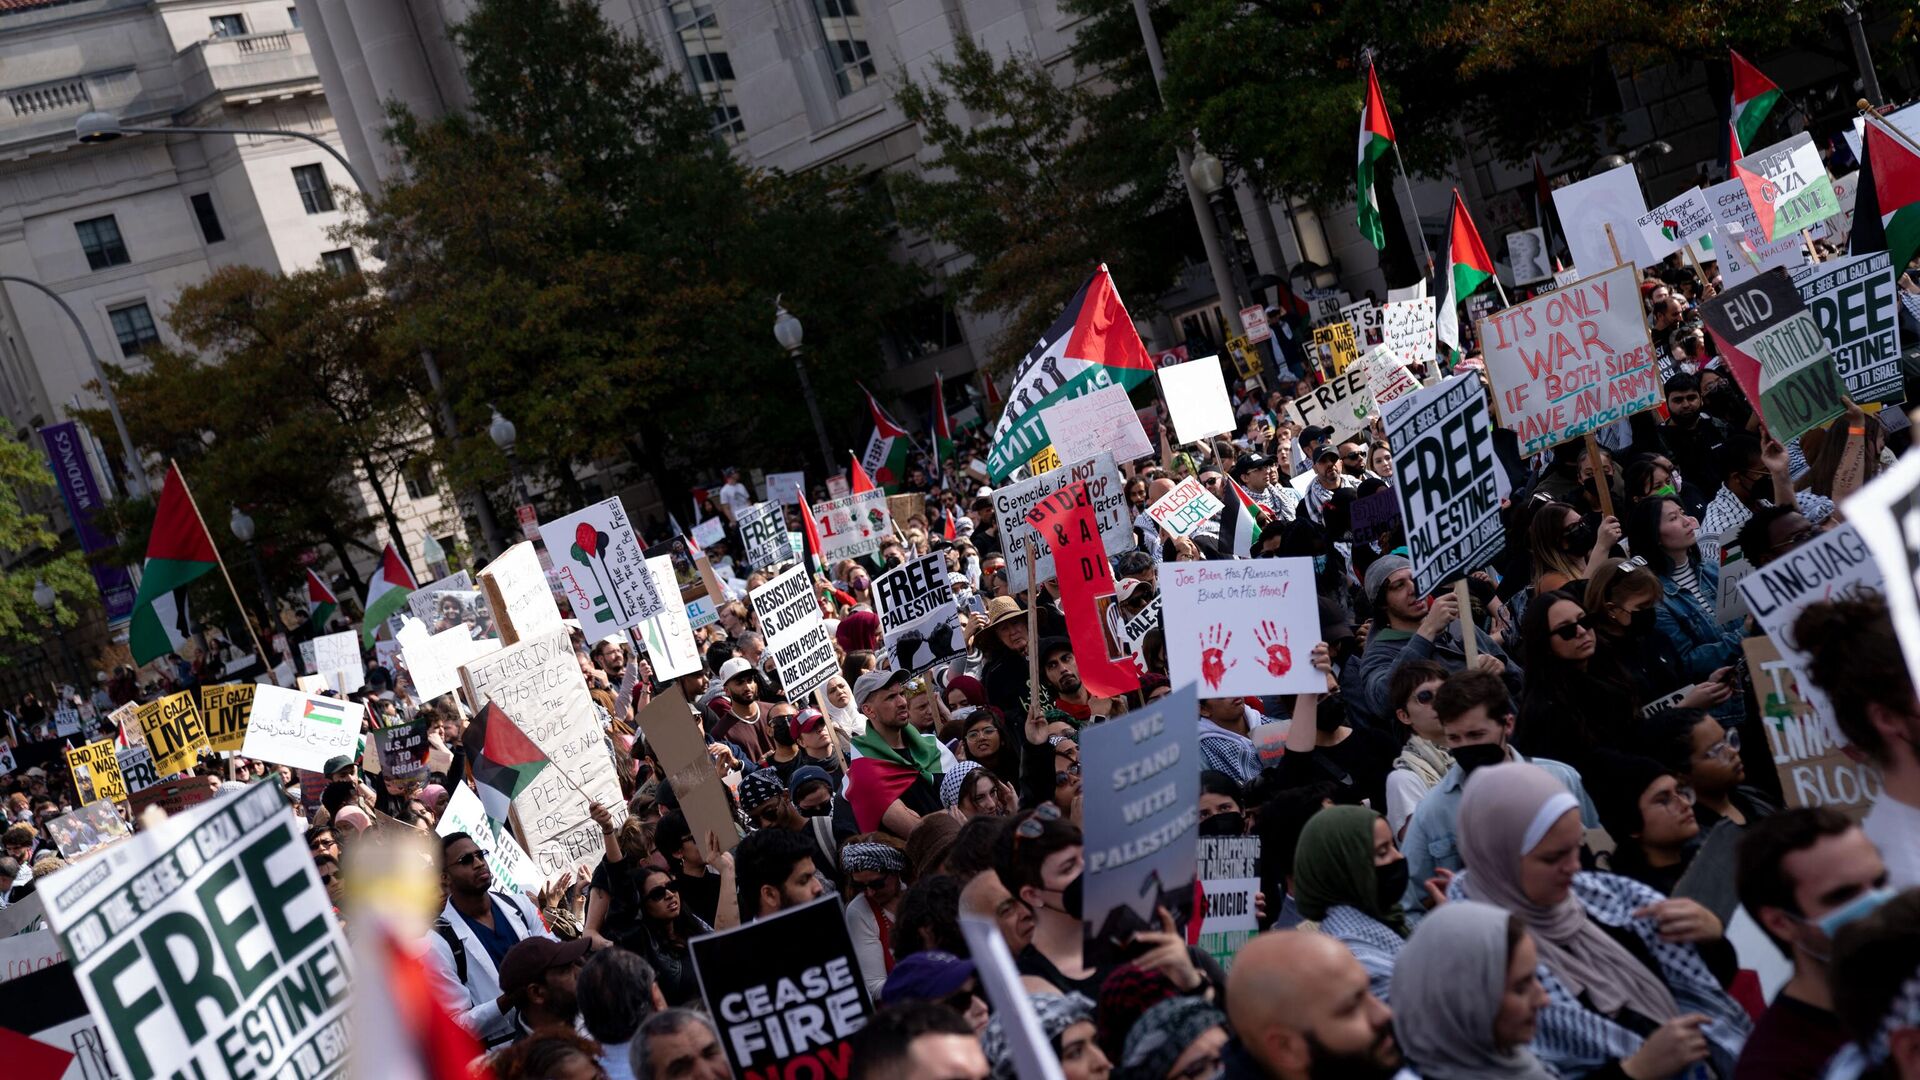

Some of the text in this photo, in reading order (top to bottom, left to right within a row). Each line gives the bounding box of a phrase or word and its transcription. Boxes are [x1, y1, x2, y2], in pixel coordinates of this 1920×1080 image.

[1760, 147, 1795, 179] LET
[1761, 171, 1807, 204] GAZA
[1779, 189, 1827, 224] LIVE
[1637, 205, 1669, 228] RESPECT
[1803, 257, 1890, 299] THE SIEGE ON GAZA NOW!
[1318, 298, 1339, 315] END
[1491, 281, 1609, 351] IT'S ONLY
[1723, 289, 1773, 332] END
[1806, 271, 1895, 351] REE
[1315, 324, 1350, 344] END THE
[1334, 339, 1354, 352] WAR
[1346, 350, 1356, 361] ON
[1518, 321, 1615, 380] WAR
[1753, 316, 1824, 379] APARTHEID
[1839, 330, 1898, 376] STINE!
[1505, 384, 1528, 413] IF
[1545, 361, 1600, 403] BOTH
[1606, 344, 1652, 375] SIDES
[1861, 372, 1870, 386] TO
[1871, 363, 1901, 383] ISRAEL
[1295, 370, 1365, 426] FREE
[1507, 365, 1656, 443] HAVE AN ARMY
[1772, 361, 1839, 432] NOW
[1391, 430, 1403, 450] END
[1403, 422, 1416, 444] THE
[1417, 412, 1437, 438] SIEGE
[1439, 404, 1447, 422] ON
[1448, 392, 1464, 416] GAZA
[1525, 394, 1655, 453] IT'S GENOCIDE!
[53, 430, 94, 509] WEDDINGS
[1032, 458, 1049, 476] LET
[1396, 396, 1492, 533] FREE
[997, 460, 1096, 513] Genocide is NOT
[609, 501, 624, 530] FREE
[742, 508, 784, 550] FREE
[820, 516, 836, 538] 1
[1053, 523, 1069, 546] &
[1168, 494, 1216, 534] LIBRE
[1410, 472, 1498, 572] PALESTINE!
[622, 530, 630, 545] BE
[749, 532, 788, 562] PALESTINE
[1417, 570, 1430, 593] END
[1441, 549, 1459, 573] U.S.
[1460, 538, 1472, 561] AID
[1473, 531, 1480, 549] TO
[1480, 513, 1503, 542] ISRAEL
[560, 565, 590, 609] فلسطين
[613, 544, 638, 617] FROM THE SEA
[638, 567, 661, 612] PALESTINE
[754, 570, 810, 616] RESISTANCE
[877, 555, 944, 614] FREE
[1175, 569, 1195, 587] Joe
[1198, 568, 1222, 581] Biden
[1224, 567, 1241, 580] Has
[1197, 588, 1225, 604] Blood
[1240, 586, 1257, 599] His
[762, 592, 817, 638] IS JUSTIFIED
[881, 585, 953, 633] PALESTINE
[473, 665, 494, 688] IF
[499, 647, 532, 677] THERE
[531, 641, 550, 663] IS
[552, 632, 569, 655] NO
[775, 624, 827, 667] WHEN PEOPLE
[783, 642, 834, 686] ARE OCCUPIED!
[203, 694, 218, 711] LET
[226, 690, 252, 705] GAZA
[495, 664, 568, 710] JUSTICE
[140, 712, 162, 733] LET
[163, 695, 193, 718] GAZA
[388, 725, 411, 738] STOP
[510, 695, 564, 726] OR THE
[1130, 713, 1164, 743] WE
[70, 744, 113, 766] END THE
[147, 708, 204, 763] LIVE!
[385, 735, 420, 751] U.S. AID
[399, 751, 411, 761] TO
[562, 732, 599, 759] BE NO
[93, 757, 117, 774] WAR
[107, 772, 119, 784] ON
[392, 760, 422, 774] ISRAEL
[531, 762, 595, 810] PEACE
[1113, 743, 1180, 791] STAND
[100, 784, 126, 799] GAZA
[1123, 784, 1176, 825] WITH
[536, 812, 567, 834] FOR
[476, 824, 515, 870] OF THE
[67, 912, 106, 960] END
[100, 889, 137, 935] THE
[131, 856, 182, 909] SIEGE
[176, 841, 203, 879] ON
[194, 809, 238, 860] GAZA
[89, 822, 328, 1080] FREE
[720, 956, 854, 1023] CEASE
[729, 986, 868, 1068] FIRE
